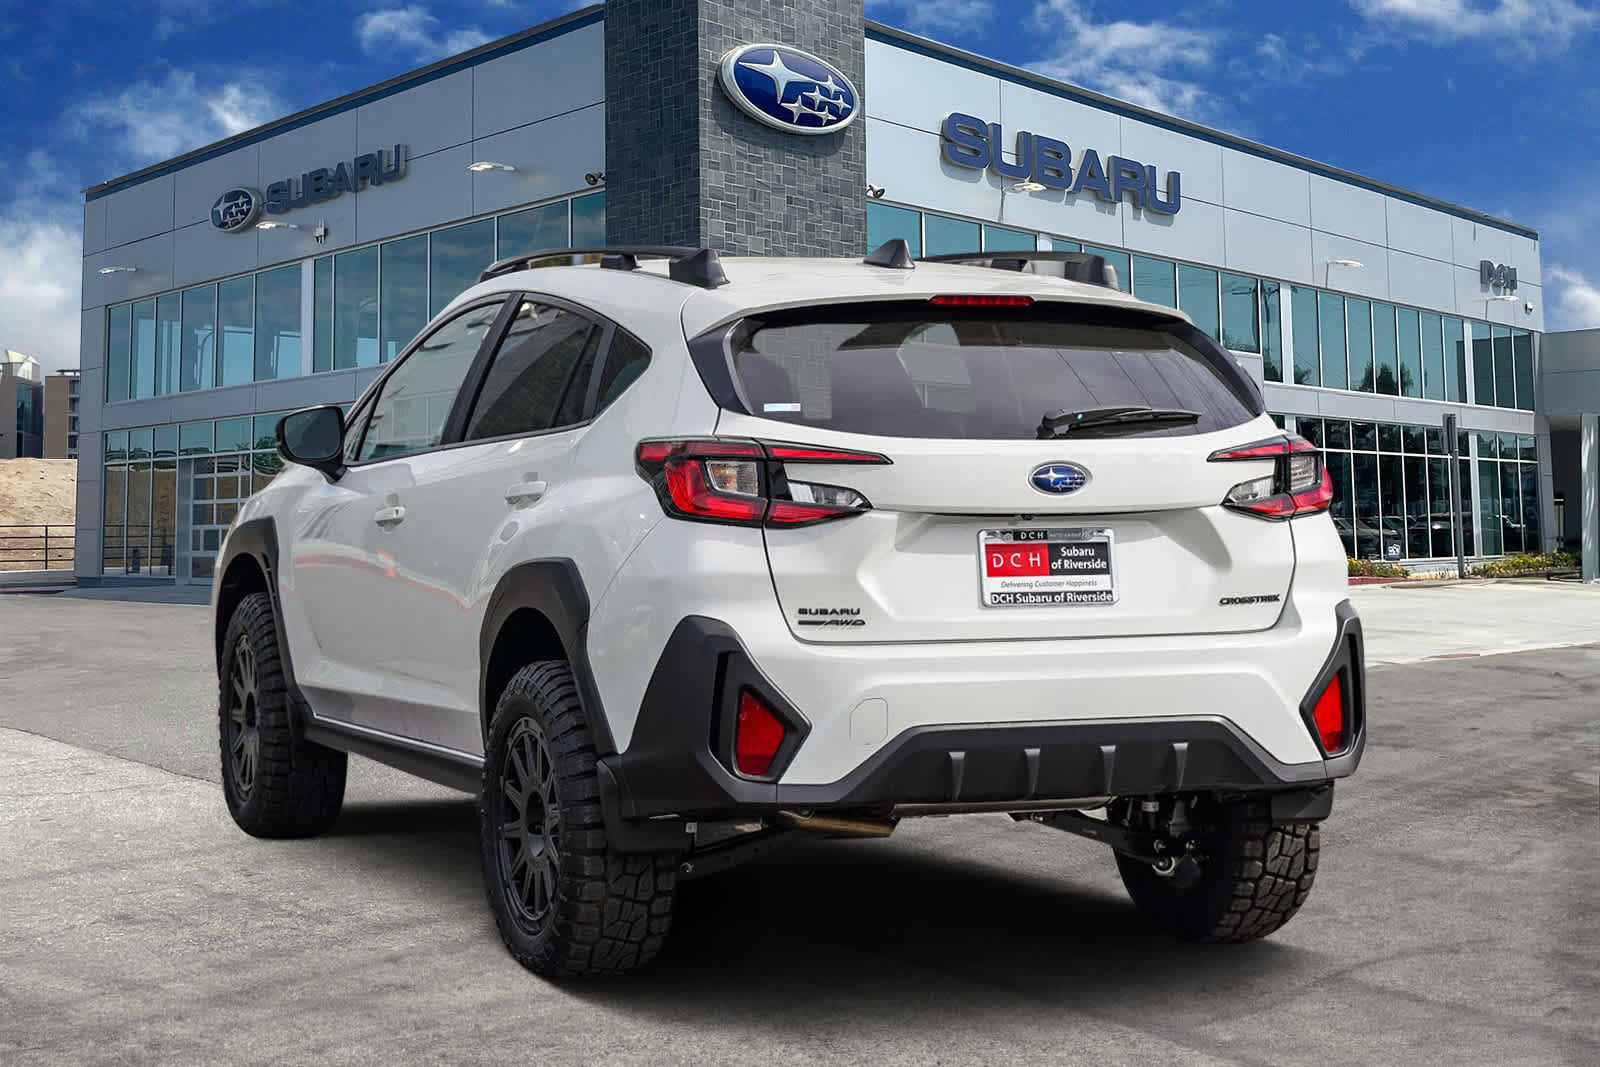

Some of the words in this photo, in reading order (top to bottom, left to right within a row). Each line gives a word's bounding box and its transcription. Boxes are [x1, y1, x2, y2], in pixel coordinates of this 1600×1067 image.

[942, 112, 1181, 215] SUBARU
[266, 144, 408, 215] SUBARU
[1060, 546, 1095, 557] Subaru
[1051, 560, 1062, 570] of
[1063, 558, 1107, 570] Riverside
[1001, 580, 1033, 589] Delivering
[1034, 580, 1064, 588] Customer
[1066, 579, 1098, 587] Happiness
[991, 593, 1014, 604] DCH
[1016, 592, 1052, 604] Subaru
[1053, 591, 1065, 603] of
[1066, 590, 1113, 602] Riverside
[1219, 594, 1281, 605] CROSSTREK
[798, 608, 861, 616] SUBARU
